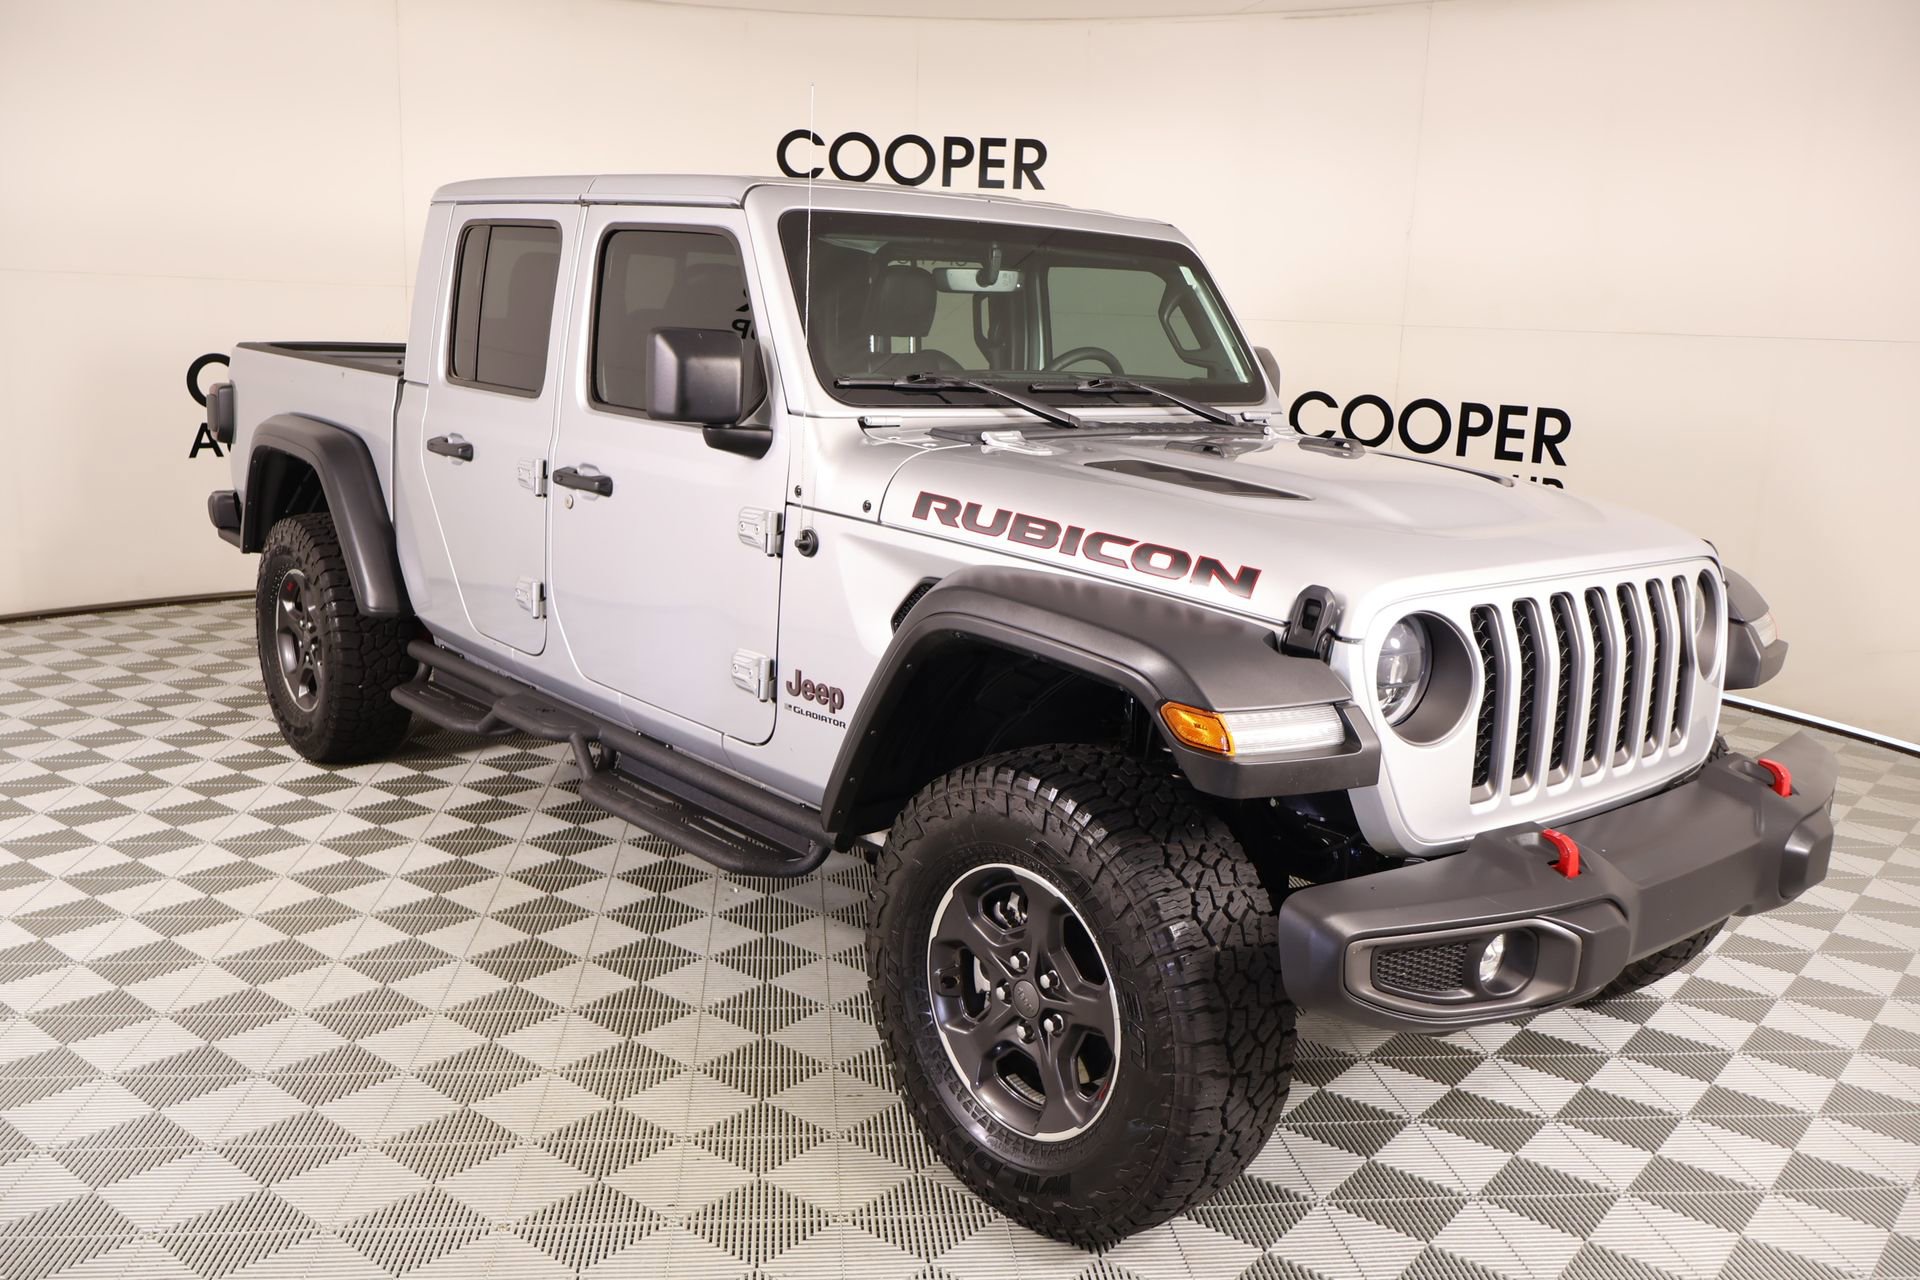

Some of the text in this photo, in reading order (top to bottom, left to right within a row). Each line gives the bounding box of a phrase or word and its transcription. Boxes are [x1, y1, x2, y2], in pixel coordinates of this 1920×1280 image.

[776, 129, 1047, 190] COOPER
[1289, 390, 1571, 466] COOPER
[912, 490, 1262, 600] RUBICON
[786, 669, 845, 714] Jeep
[793, 705, 847, 729] GLADIATOR
